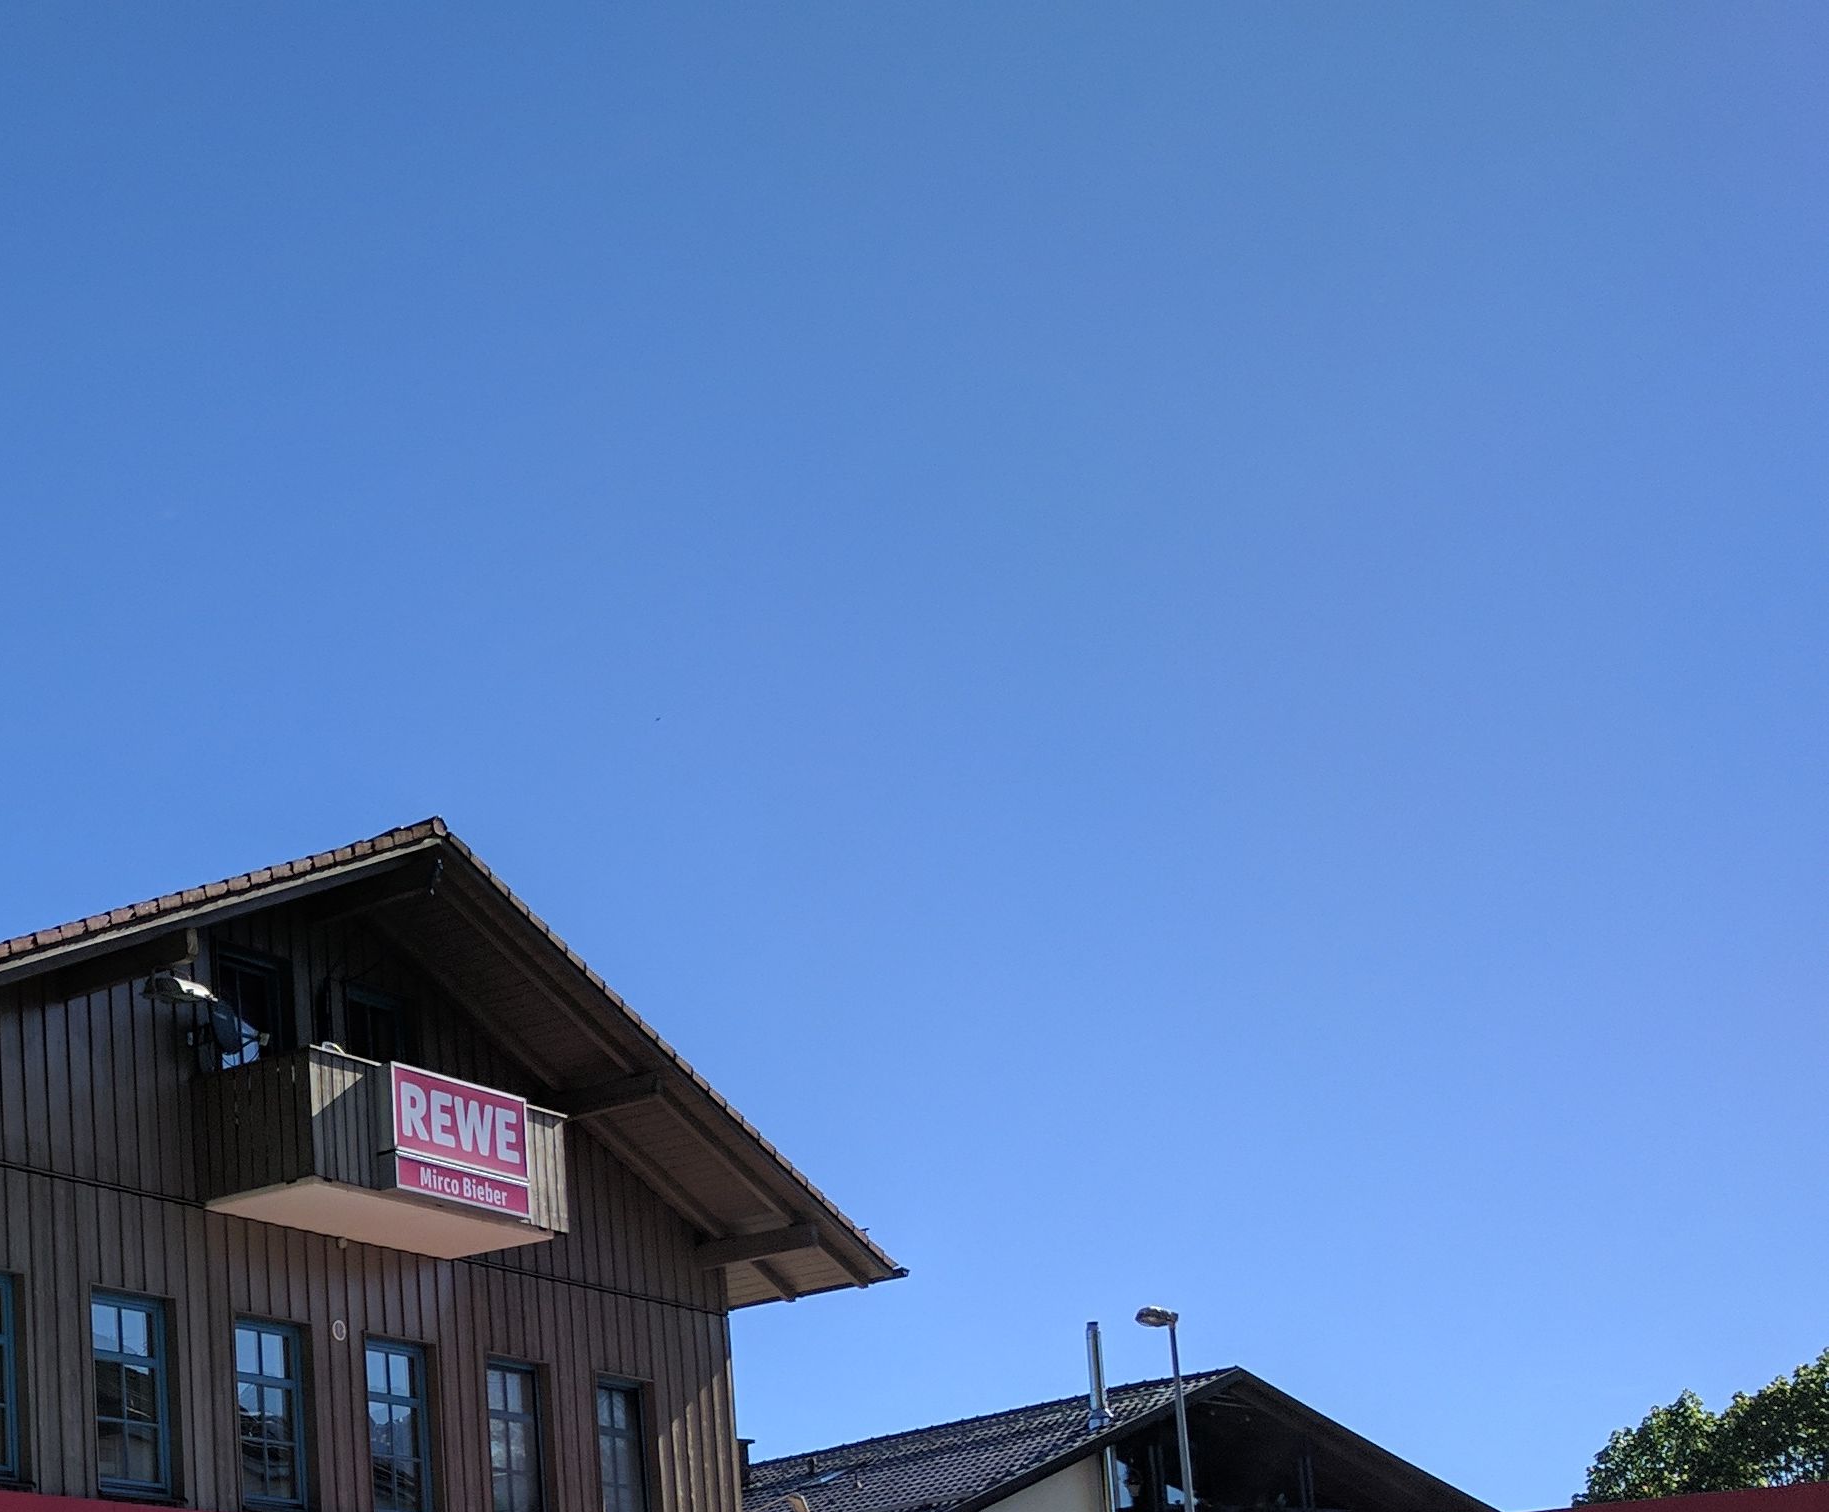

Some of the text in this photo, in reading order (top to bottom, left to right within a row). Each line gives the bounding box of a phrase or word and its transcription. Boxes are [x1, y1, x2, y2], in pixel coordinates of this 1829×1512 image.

[400, 1081, 520, 1164] REWE
[420, 1166, 508, 1206] Mirco Bieber
